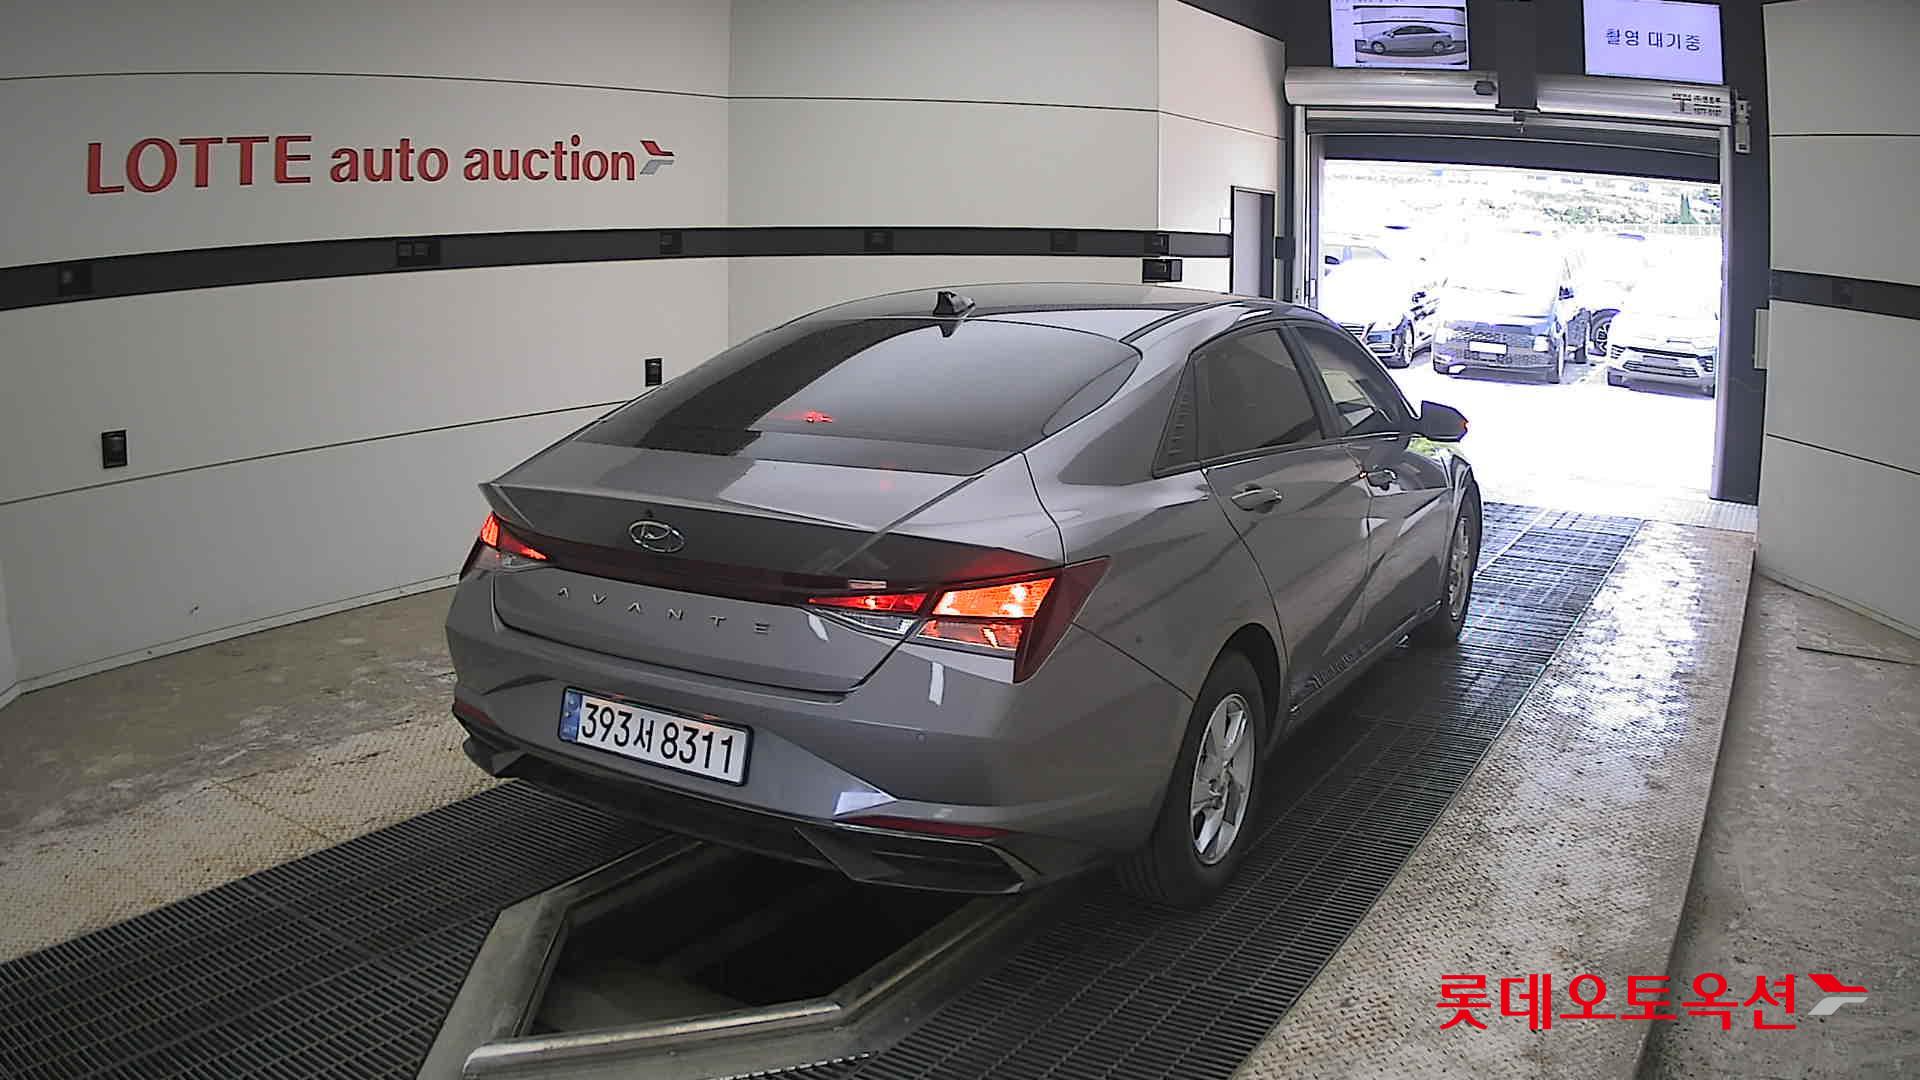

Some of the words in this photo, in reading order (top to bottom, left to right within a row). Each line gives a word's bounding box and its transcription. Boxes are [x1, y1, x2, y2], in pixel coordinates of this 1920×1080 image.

[87, 135, 312, 195] LOTTE
[329, 138, 450, 184] auto
[463, 134, 635, 183] auction
[557, 586, 771, 633] AVANTE
[581, 702, 654, 753] 393서
[660, 722, 733, 774] 8311
